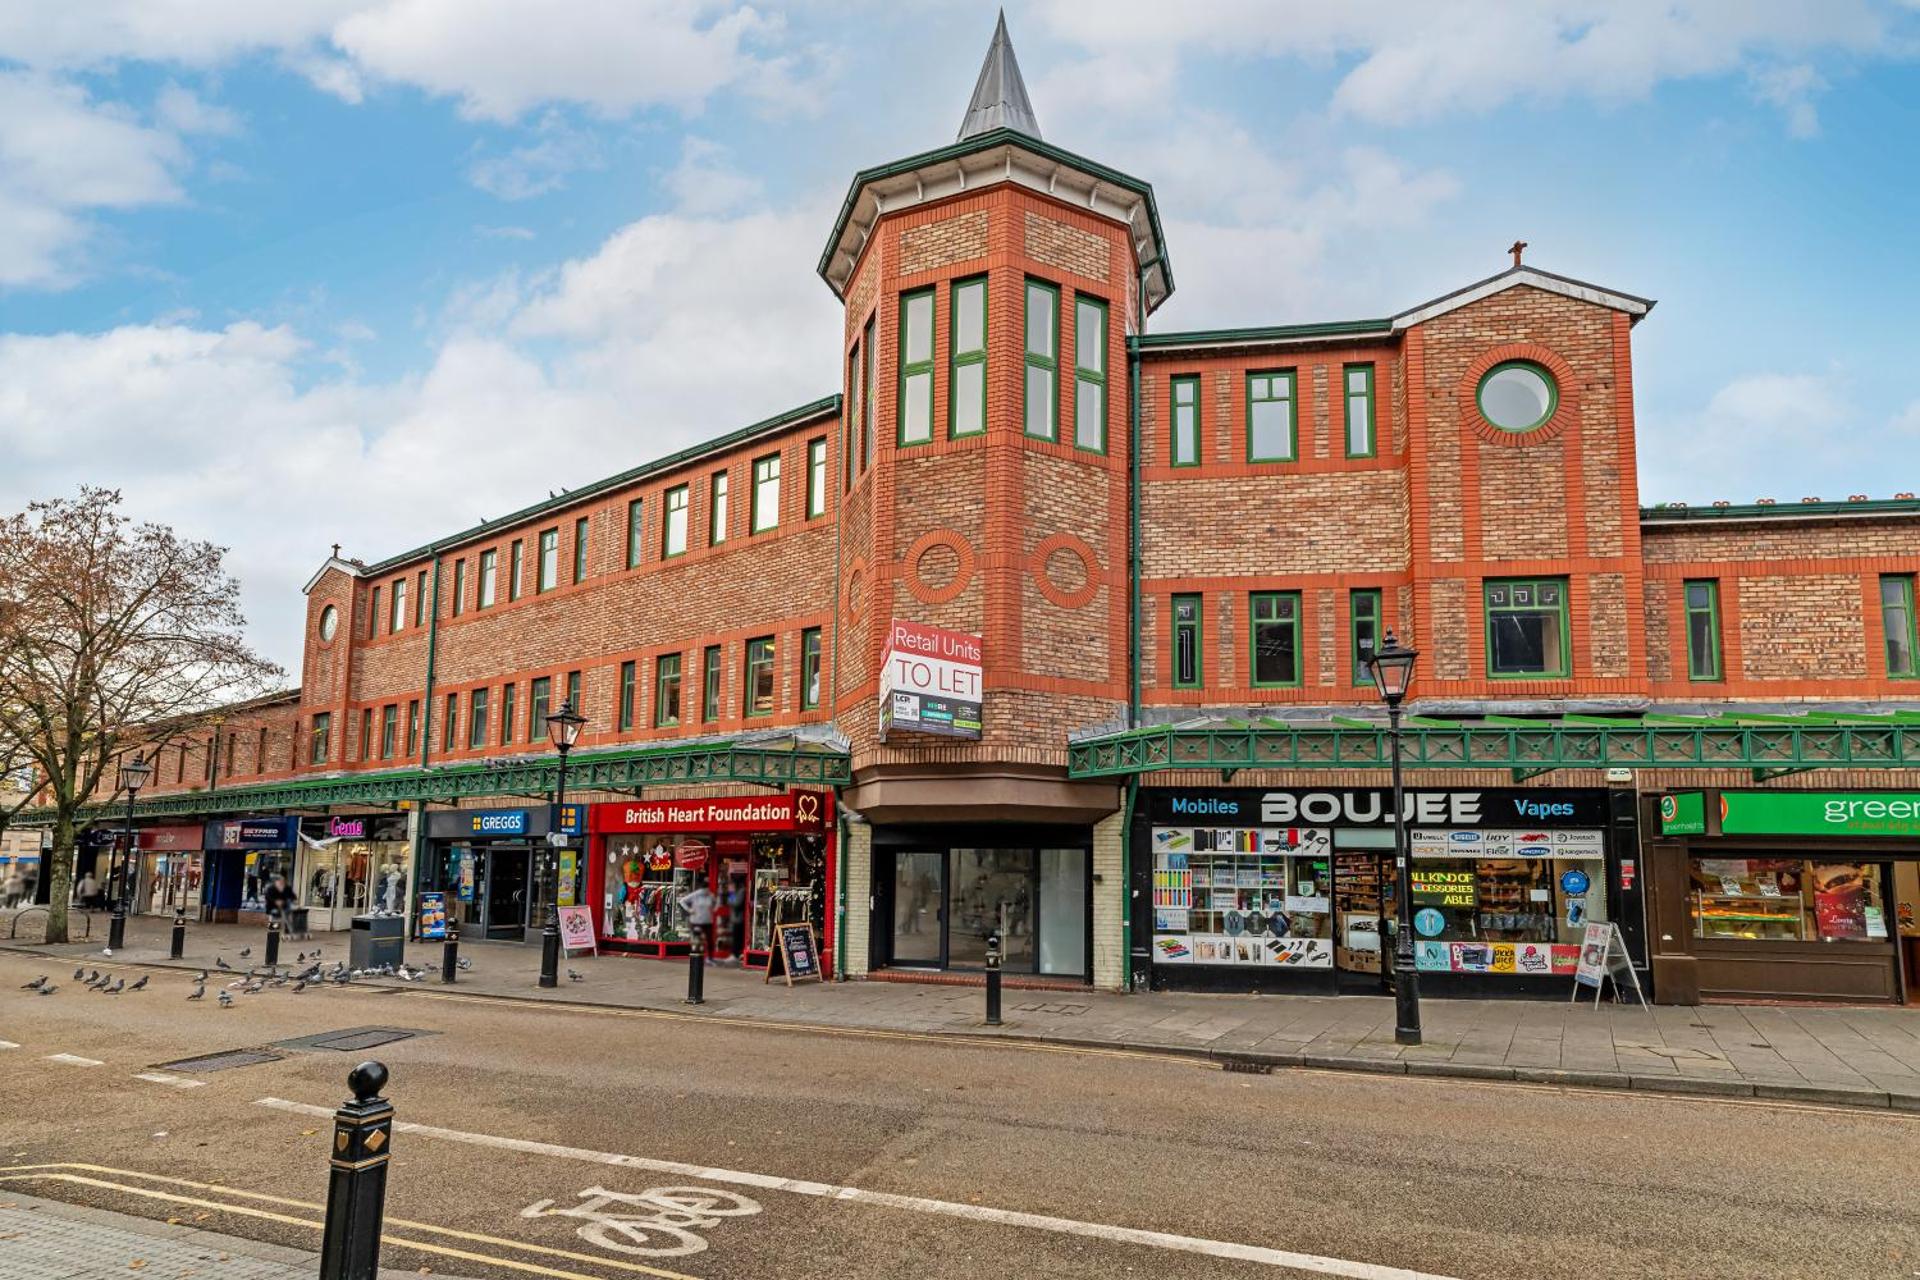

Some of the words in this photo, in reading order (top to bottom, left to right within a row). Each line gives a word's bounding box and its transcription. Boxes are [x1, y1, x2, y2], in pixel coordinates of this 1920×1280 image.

[895, 626, 939, 653] Retail
[943, 636, 981, 661] Units
[895, 658, 931, 688] TO
[939, 666, 980, 695] LET
[625, 806, 665, 824] British
[668, 804, 705, 822] Heart
[708, 803, 791, 821] Foundation
[1172, 798, 1238, 815] Mobiles
[1261, 792, 1483, 824] BOUJEE
[1514, 799, 1575, 819] Vapes
[482, 815, 521, 830] GREGGS
[1458, 873, 1474, 883] OF
